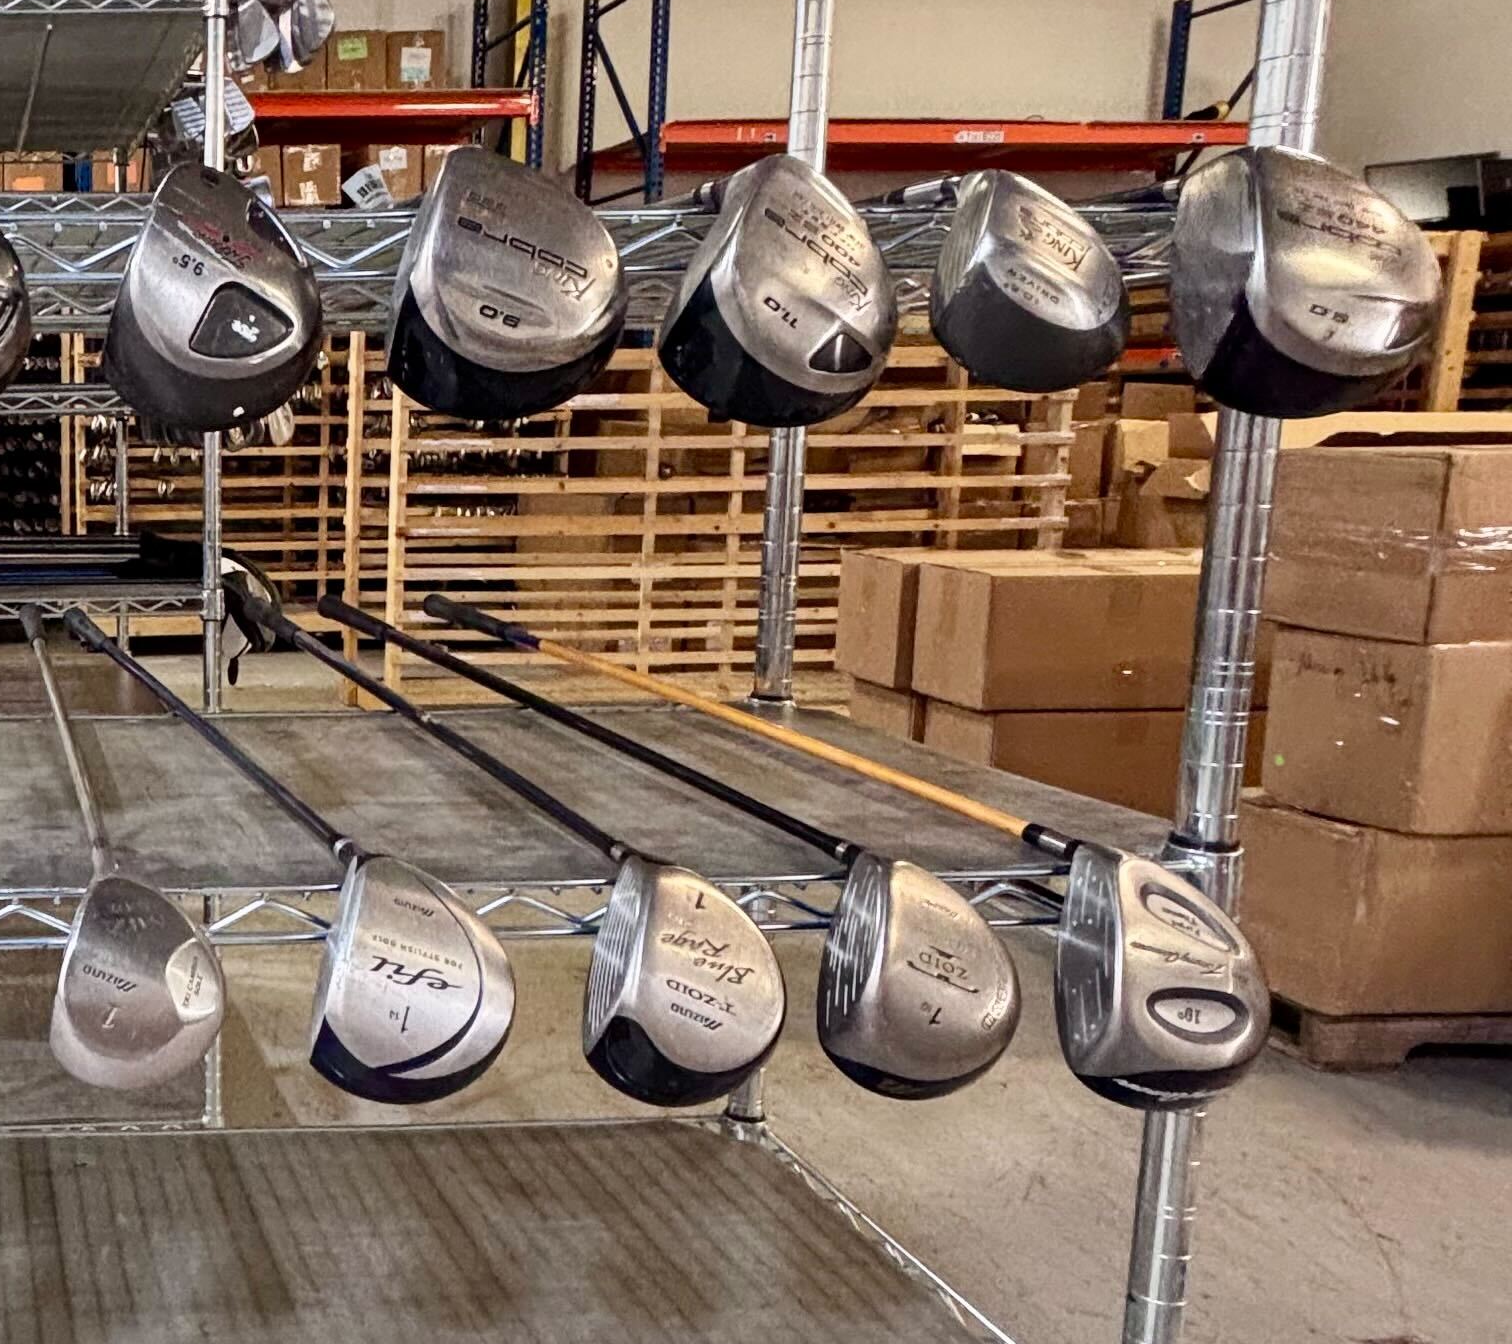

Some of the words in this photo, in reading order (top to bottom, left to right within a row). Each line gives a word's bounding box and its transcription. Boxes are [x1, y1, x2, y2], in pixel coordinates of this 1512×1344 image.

[172, 254, 205, 277] 9.5°
[1042, 231, 1090, 273] KING
[1005, 267, 1060, 305] DRIVER
[479, 304, 521, 329] 9.0
[763, 296, 800, 329] 11.0
[694, 892, 707, 911] 1
[399, 942, 441, 964] STYLISH
[659, 929, 730, 959] Rage
[693, 955, 755, 985] Blue
[918, 950, 968, 980] ZOID
[666, 978, 738, 1017] T-ZOID
[670, 1002, 724, 1032] MIZUNO
[1176, 1007, 1202, 1026] 10°
